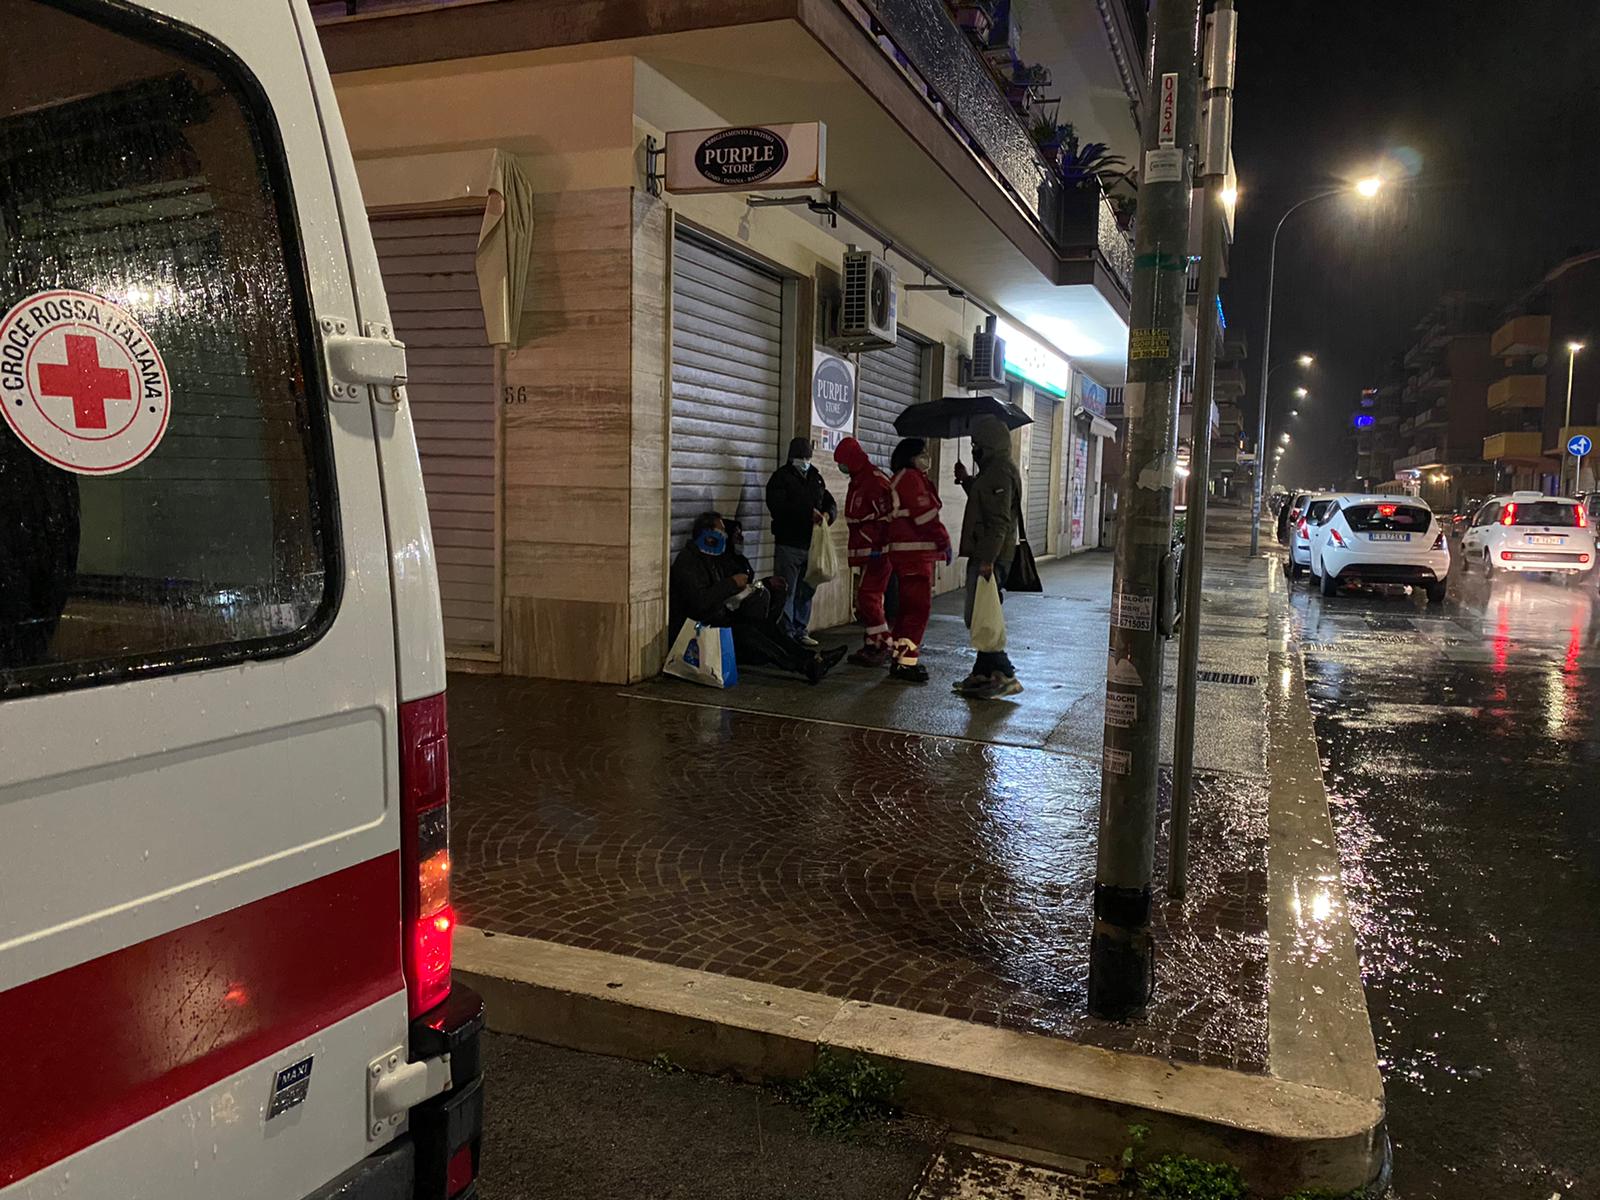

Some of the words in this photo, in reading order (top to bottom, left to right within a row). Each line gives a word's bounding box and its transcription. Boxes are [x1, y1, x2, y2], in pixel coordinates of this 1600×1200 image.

[1163, 77, 1173, 135] 0454
[704, 145, 774, 165] PURPLE
[721, 163, 755, 174] STORE
[2, 317, 37, 392] CROCE
[28, 298, 101, 328] ROSSA
[504, 385, 527, 405] 56
[817, 379, 849, 403] PURPLE
[825, 402, 841, 413] STORE
[281, 1063, 308, 1085] MAXI
